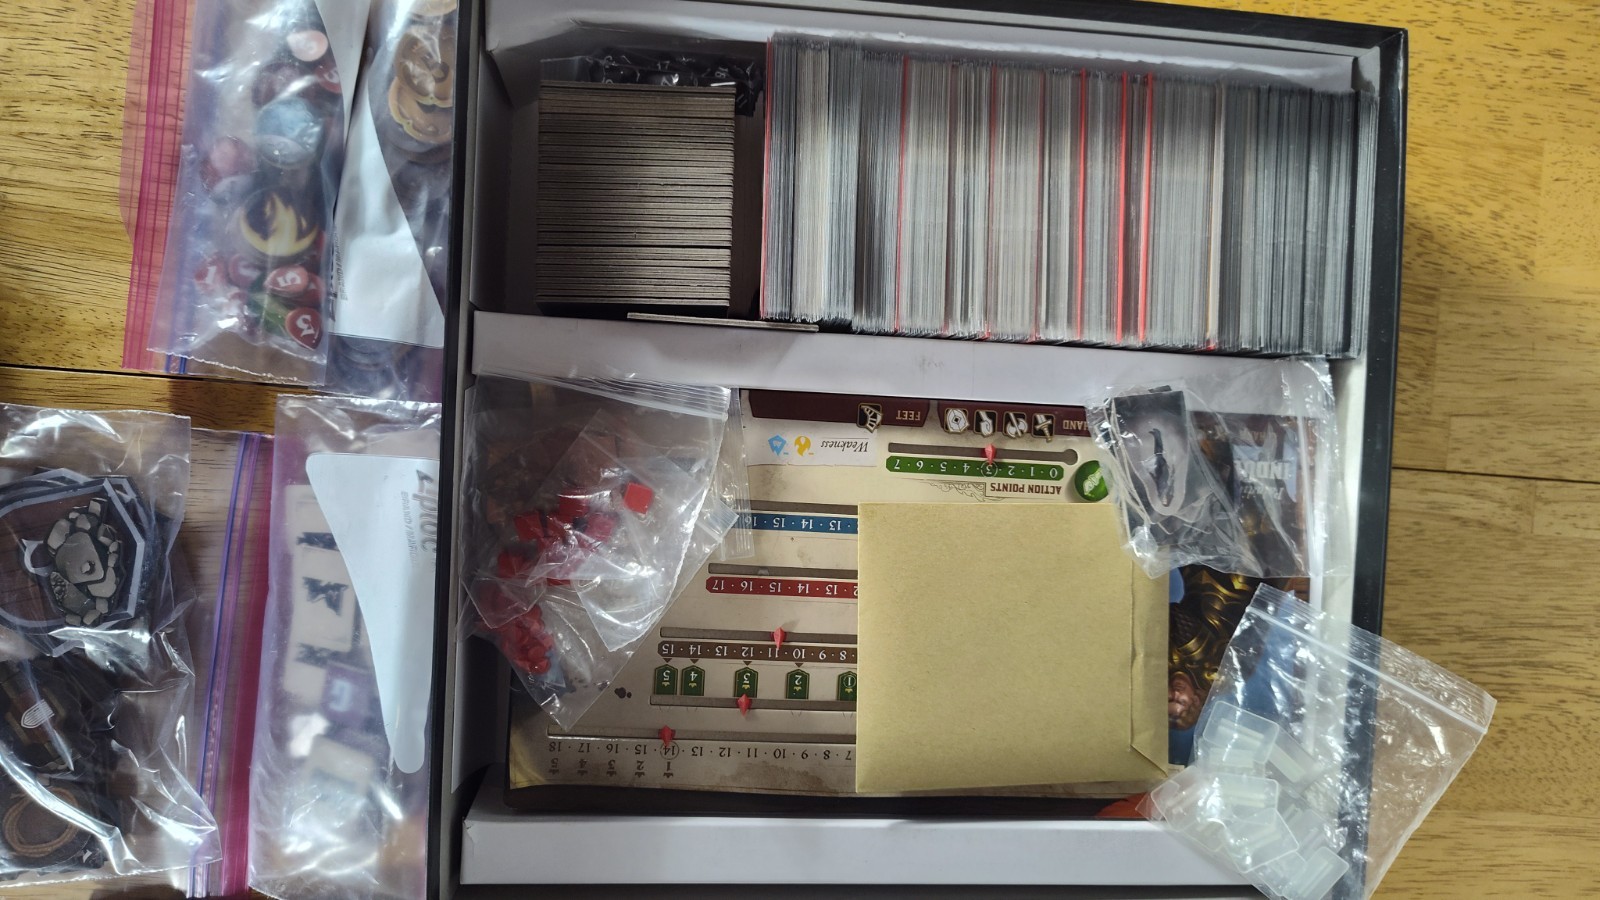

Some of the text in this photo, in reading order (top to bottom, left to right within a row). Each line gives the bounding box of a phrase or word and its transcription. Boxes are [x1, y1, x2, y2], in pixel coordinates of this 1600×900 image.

[277, 271, 300, 288] 5
[296, 314, 315, 338] 5
[896, 410, 921, 421] FEET
[820, 440, 869, 452] Weakness
[893, 460, 1058, 478] 0 1 2 3 4 5 6 7
[990, 483, 1062, 495] ACTION POINTS
[744, 516, 841, 531] 13 14 15 16
[712, 579, 725, 591] 17
[740, 580, 753, 592] 16
[769, 582, 782, 593] 15
[797, 582, 810, 594] 14
[825, 584, 838, 596] 13
[662, 644, 848, 660] 8 9 10 11 12 13 14 15
[662, 670, 670, 681] 5
[689, 670, 698, 682] 4
[743, 672, 751, 684] 3
[794, 674, 802, 686] 2
[549, 741, 852, 760] 7 8 9 10 11 12 13 14 15 16 17 18
[551, 758, 672, 772] 1 2 3 4 5
